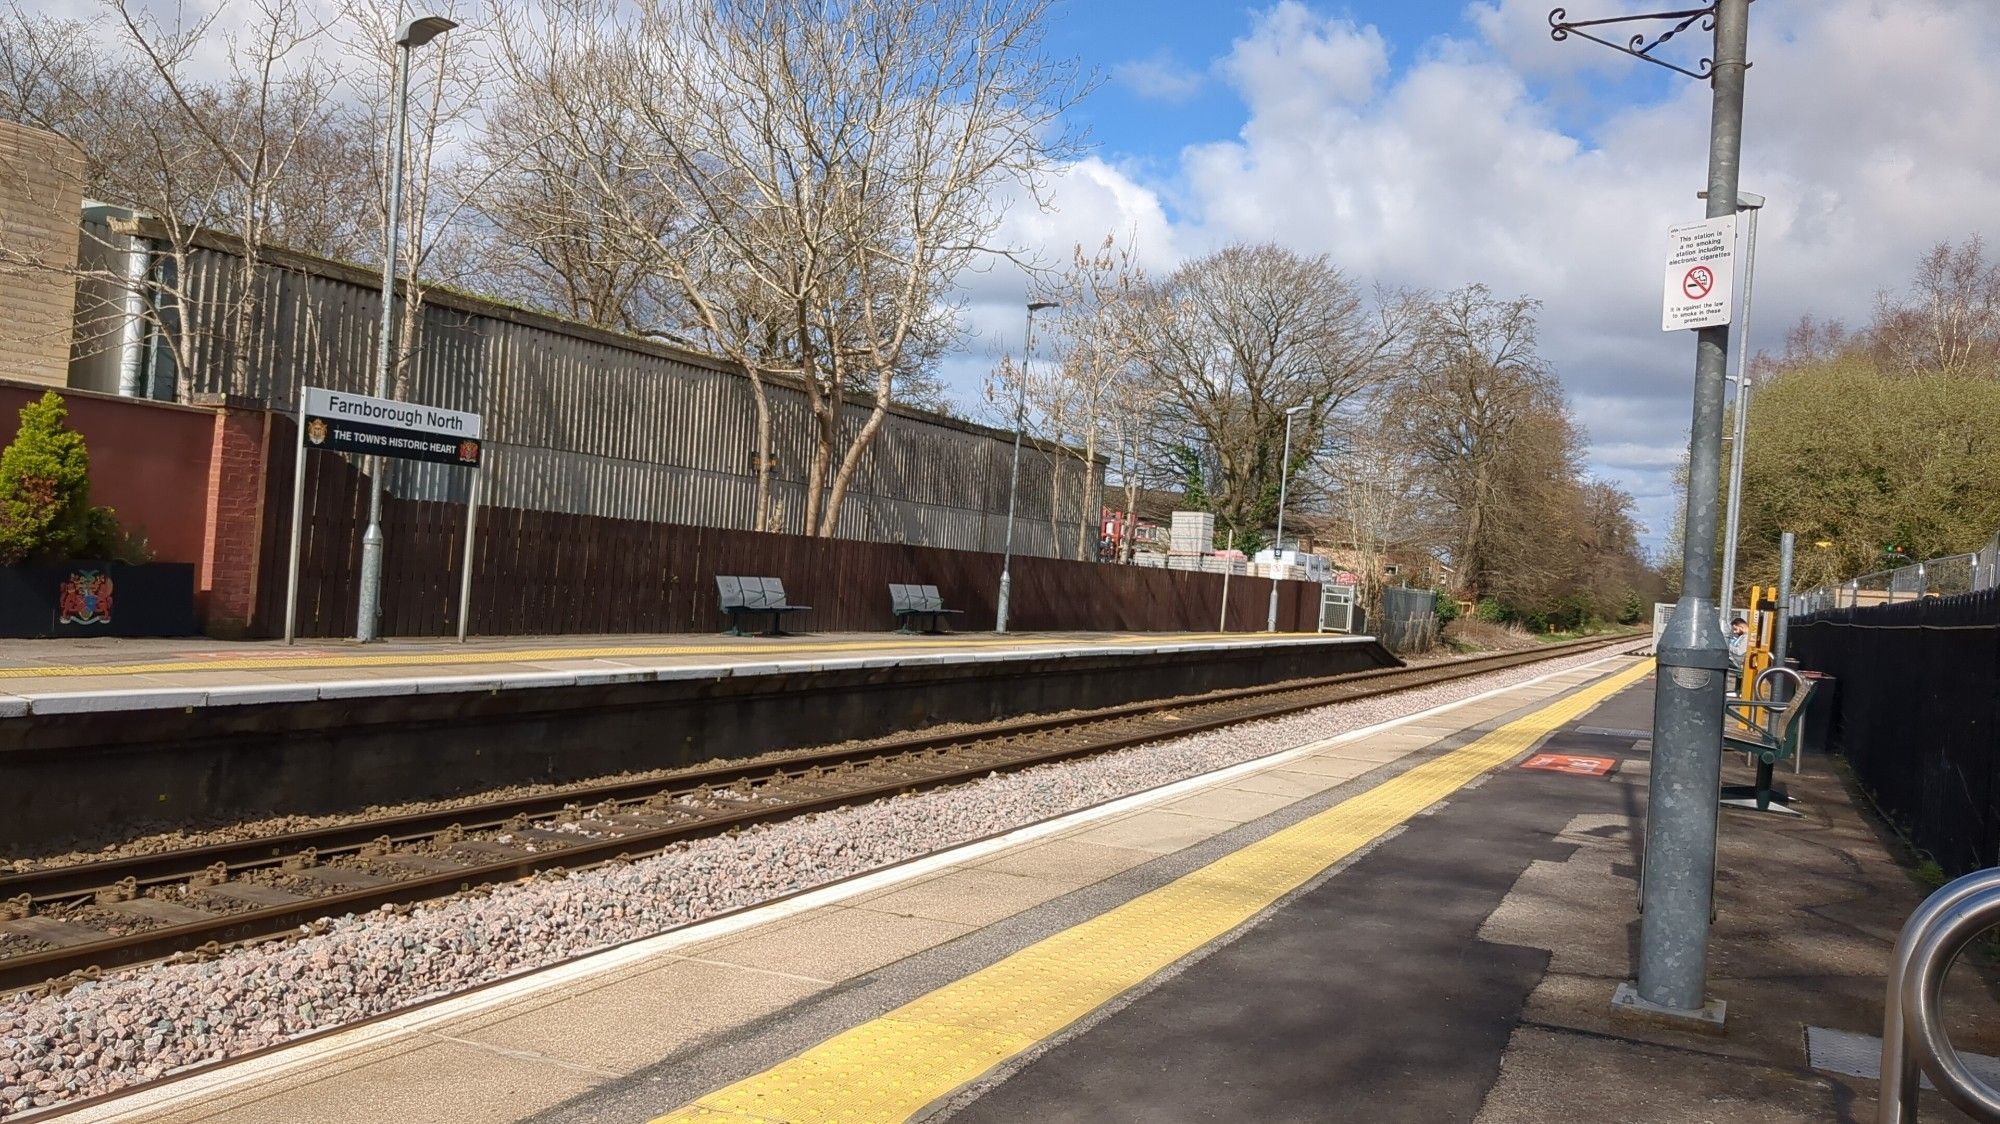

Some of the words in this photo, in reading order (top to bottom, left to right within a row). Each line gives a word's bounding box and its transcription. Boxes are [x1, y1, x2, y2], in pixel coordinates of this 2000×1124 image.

[1694, 232, 1714, 240] station
[1696, 239, 1721, 247] smoking
[1698, 246, 1724, 254] including
[1669, 256, 1698, 265] electronic
[1700, 252, 1730, 262] cigarettes
[329, 396, 422, 426] Farnborough
[427, 411, 463, 430] North
[333, 430, 352, 441] THE
[353, 432, 387, 446] TOWN'S
[389, 437, 428, 451] HISTORIC
[430, 442, 456, 454] HEART
